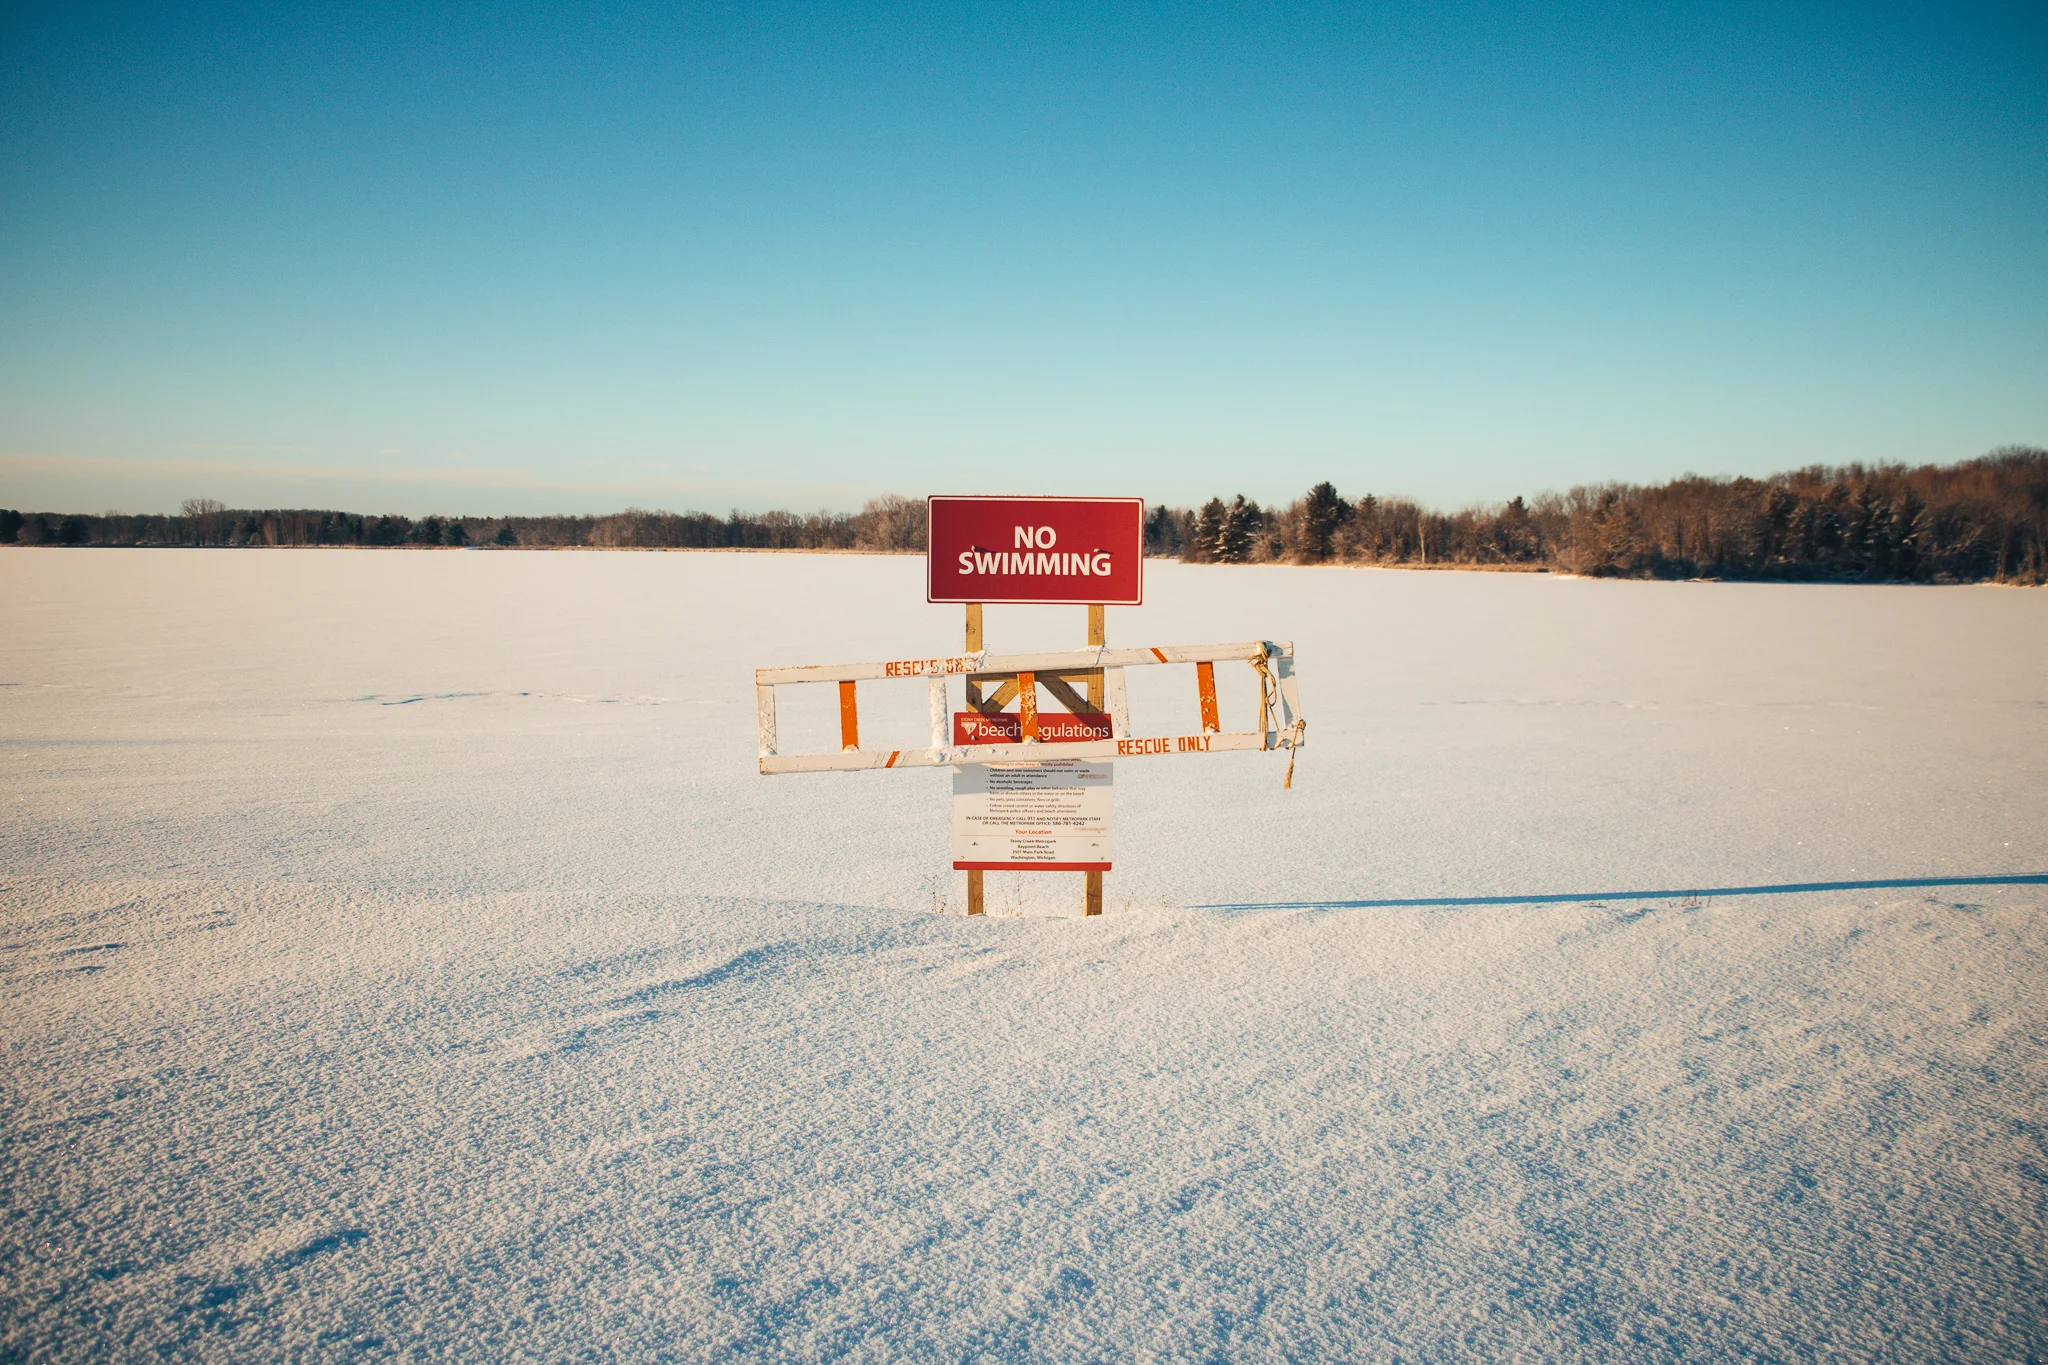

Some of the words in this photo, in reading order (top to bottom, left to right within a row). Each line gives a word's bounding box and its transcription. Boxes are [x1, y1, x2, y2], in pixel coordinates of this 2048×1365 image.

[1014, 526, 1057, 550] NO
[958, 552, 1111, 577] SWIMMING
[978, 722, 1022, 737] beach
[1038, 723, 1109, 740] egulations
[1117, 738, 1170, 755] RESCUE
[1178, 736, 1211, 752] ONLY
